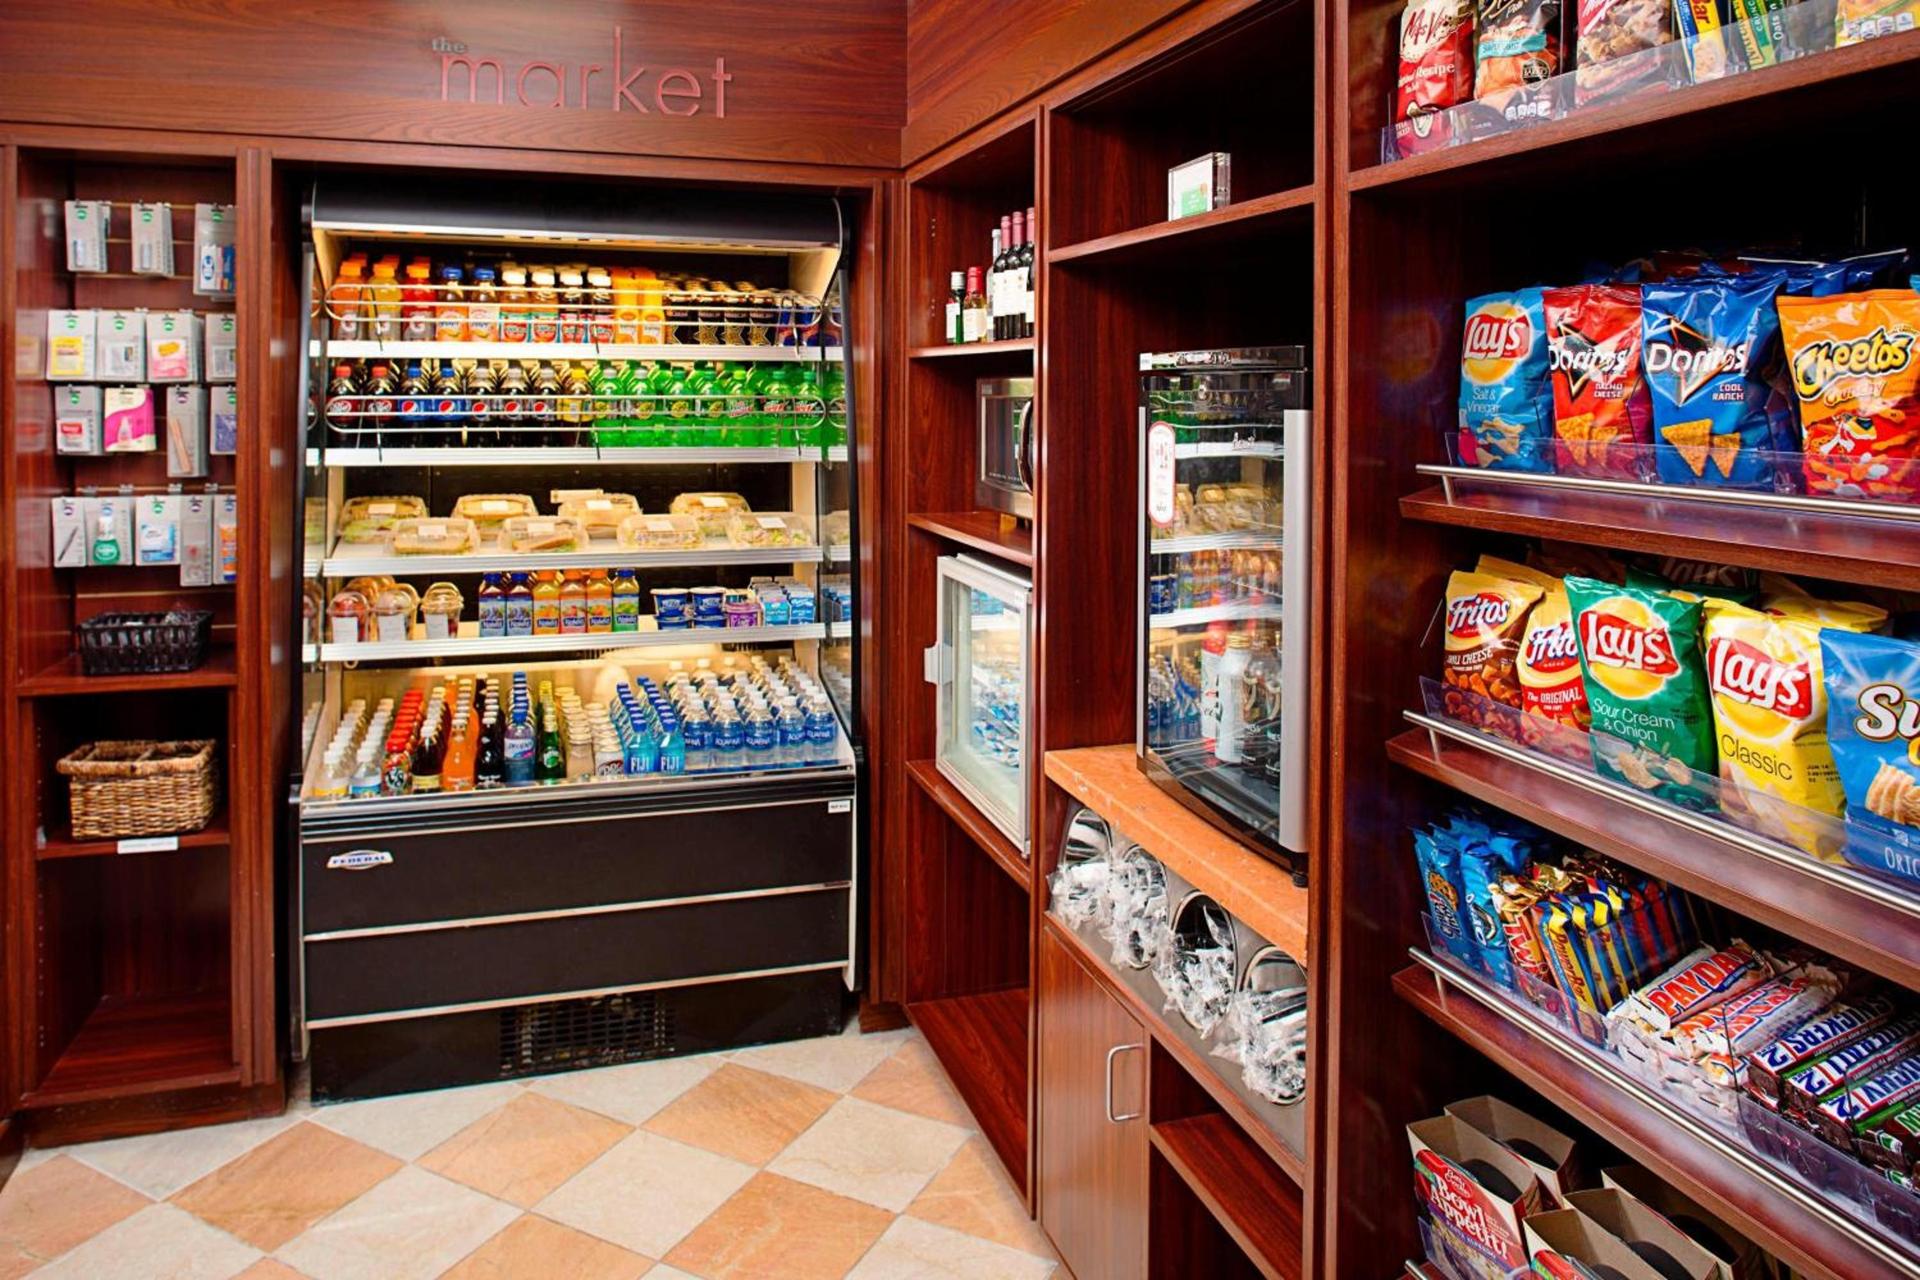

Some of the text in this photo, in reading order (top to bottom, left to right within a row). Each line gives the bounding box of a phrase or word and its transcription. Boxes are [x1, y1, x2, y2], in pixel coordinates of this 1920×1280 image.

[431, 36, 467, 54] the
[440, 25, 733, 119] market
[1463, 316, 1528, 360] Lay's
[1646, 340, 1749, 374] Doritos
[1795, 328, 1913, 399] Cheetos
[1472, 387, 1490, 401] Salt
[1711, 391, 1745, 401] RANCH
[1719, 383, 1743, 392] COOL
[1450, 595, 1511, 634] Fritos
[1587, 612, 1667, 671] Lay's
[1712, 638, 1808, 712] Lay's
[1540, 686, 1583, 704] ORIGINAL
[1592, 697, 1675, 730] Sour Cream
[1603, 719, 1658, 742] & Onion
[630, 757, 650, 773] FIJI
[660, 756, 680, 772] FIJI
[1720, 733, 1793, 781] Classic
[1766, 1047, 1789, 1068] 2
[1803, 1071, 1827, 1095] 2
[1835, 1095, 1862, 1118] 2
[1433, 1172, 1488, 1237] Bowl
